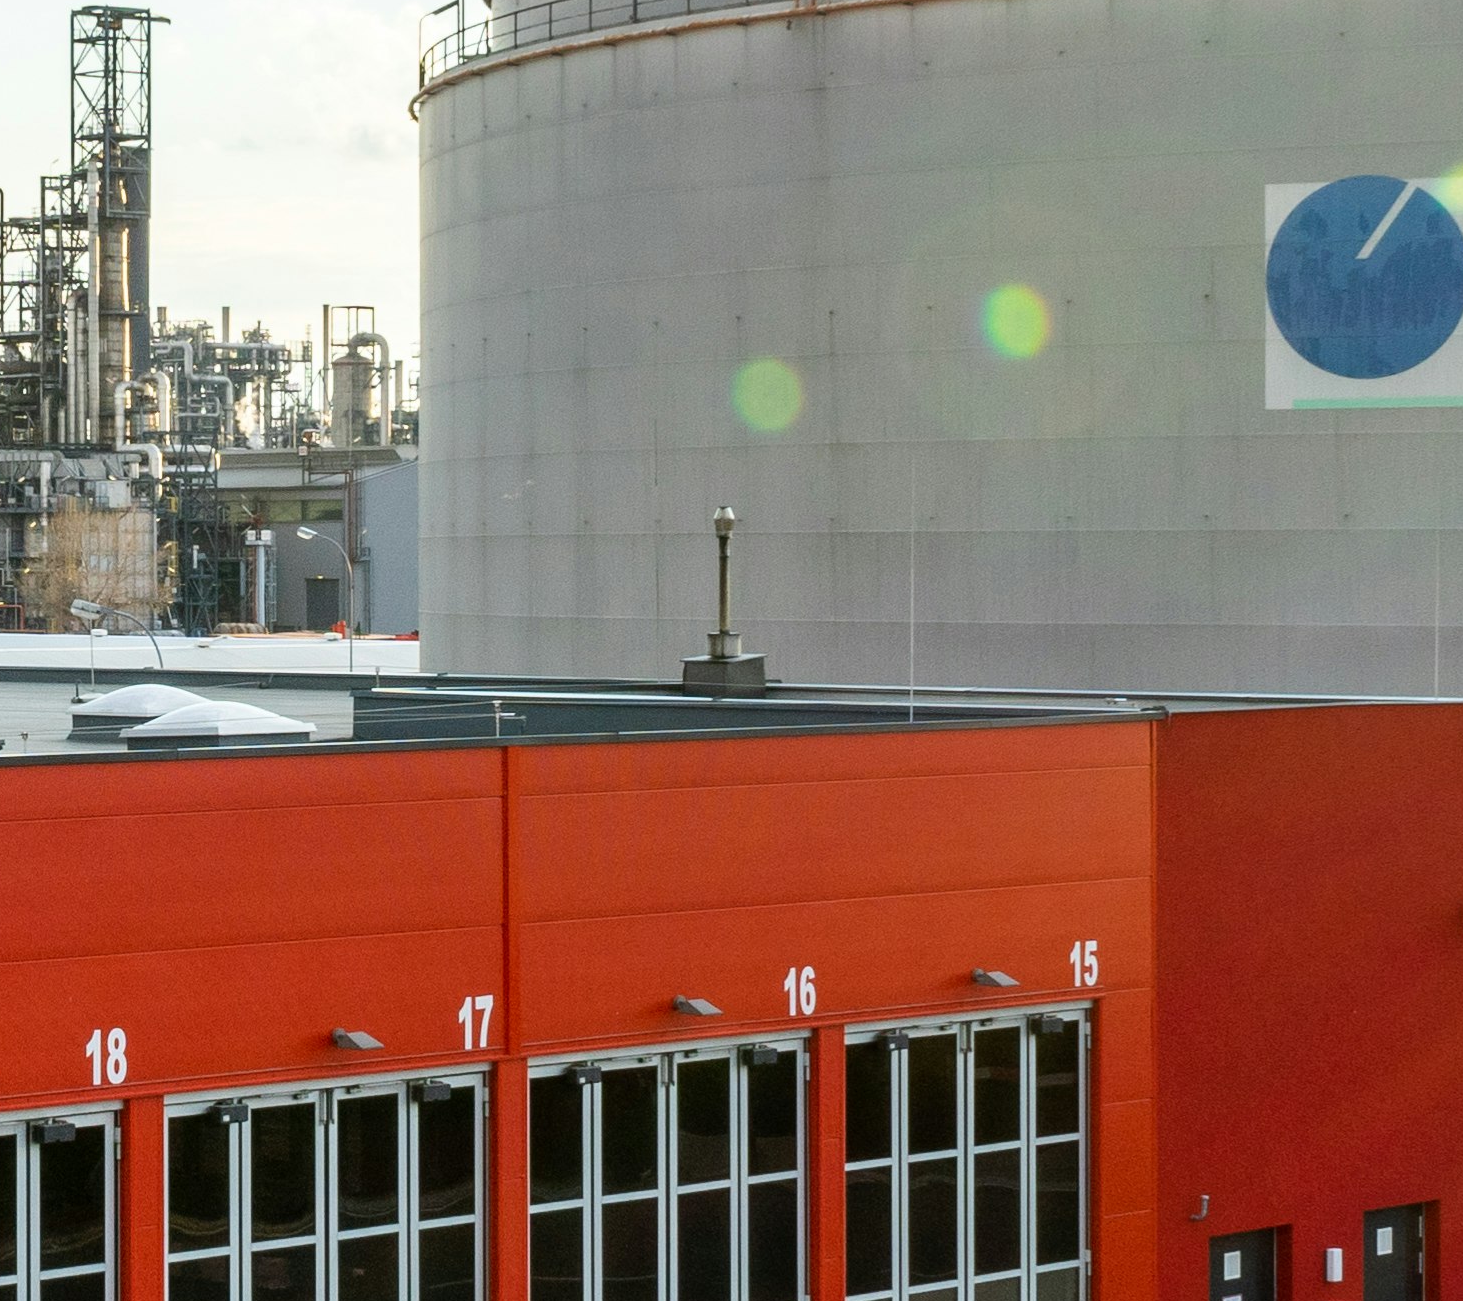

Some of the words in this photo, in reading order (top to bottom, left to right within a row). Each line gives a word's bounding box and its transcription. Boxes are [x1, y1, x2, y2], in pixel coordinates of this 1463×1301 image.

[1069, 939, 1098, 987] 15
[783, 965, 816, 1016] 16
[458, 994, 494, 1050] 17
[86, 1028, 127, 1085] 18
